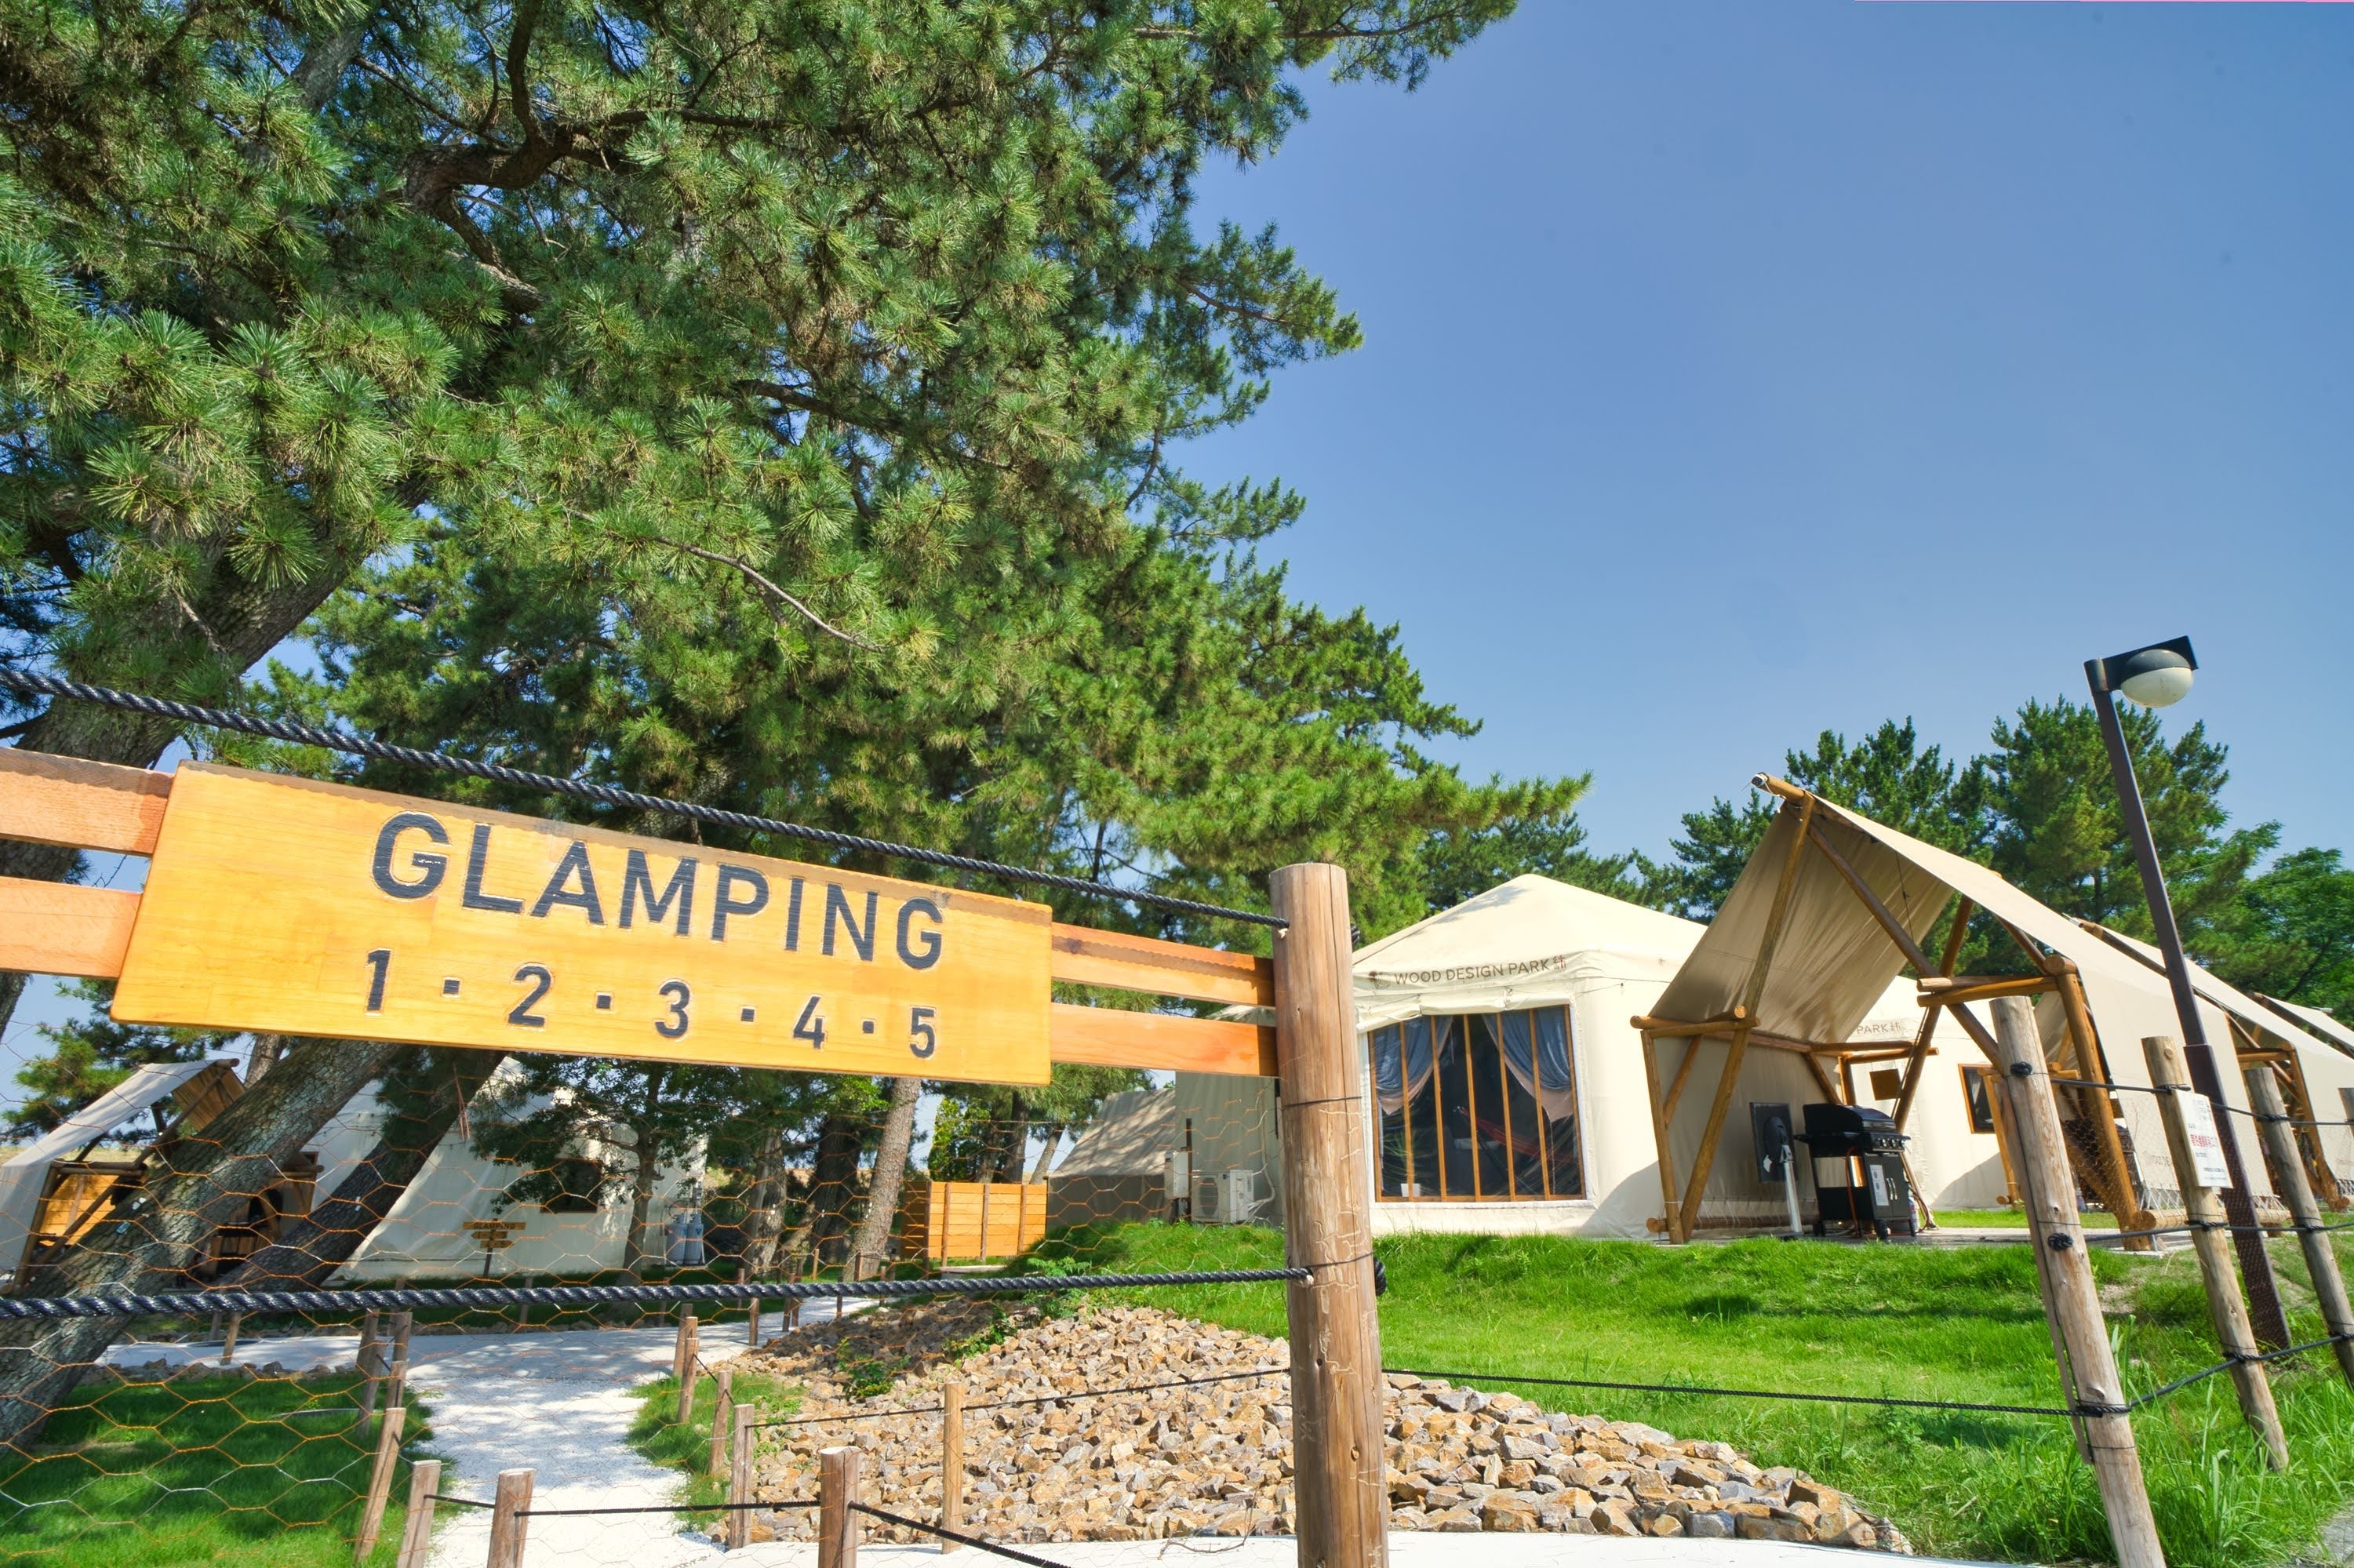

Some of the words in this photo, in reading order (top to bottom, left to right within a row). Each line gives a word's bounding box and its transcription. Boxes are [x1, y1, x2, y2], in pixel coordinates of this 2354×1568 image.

[372, 813, 943, 970] GLAMPING
[367, 949, 391, 1011] 1
[508, 965, 551, 1028] 2
[655, 980, 689, 1038] 3
[793, 995, 825, 1049] 4
[909, 1006, 935, 1057] 5
[1394, 970, 1442, 985] WOOD
[1446, 963, 1504, 980] DESIGN
[1508, 959, 1550, 975] PARK
[1857, 1023, 1889, 1035] PARK
